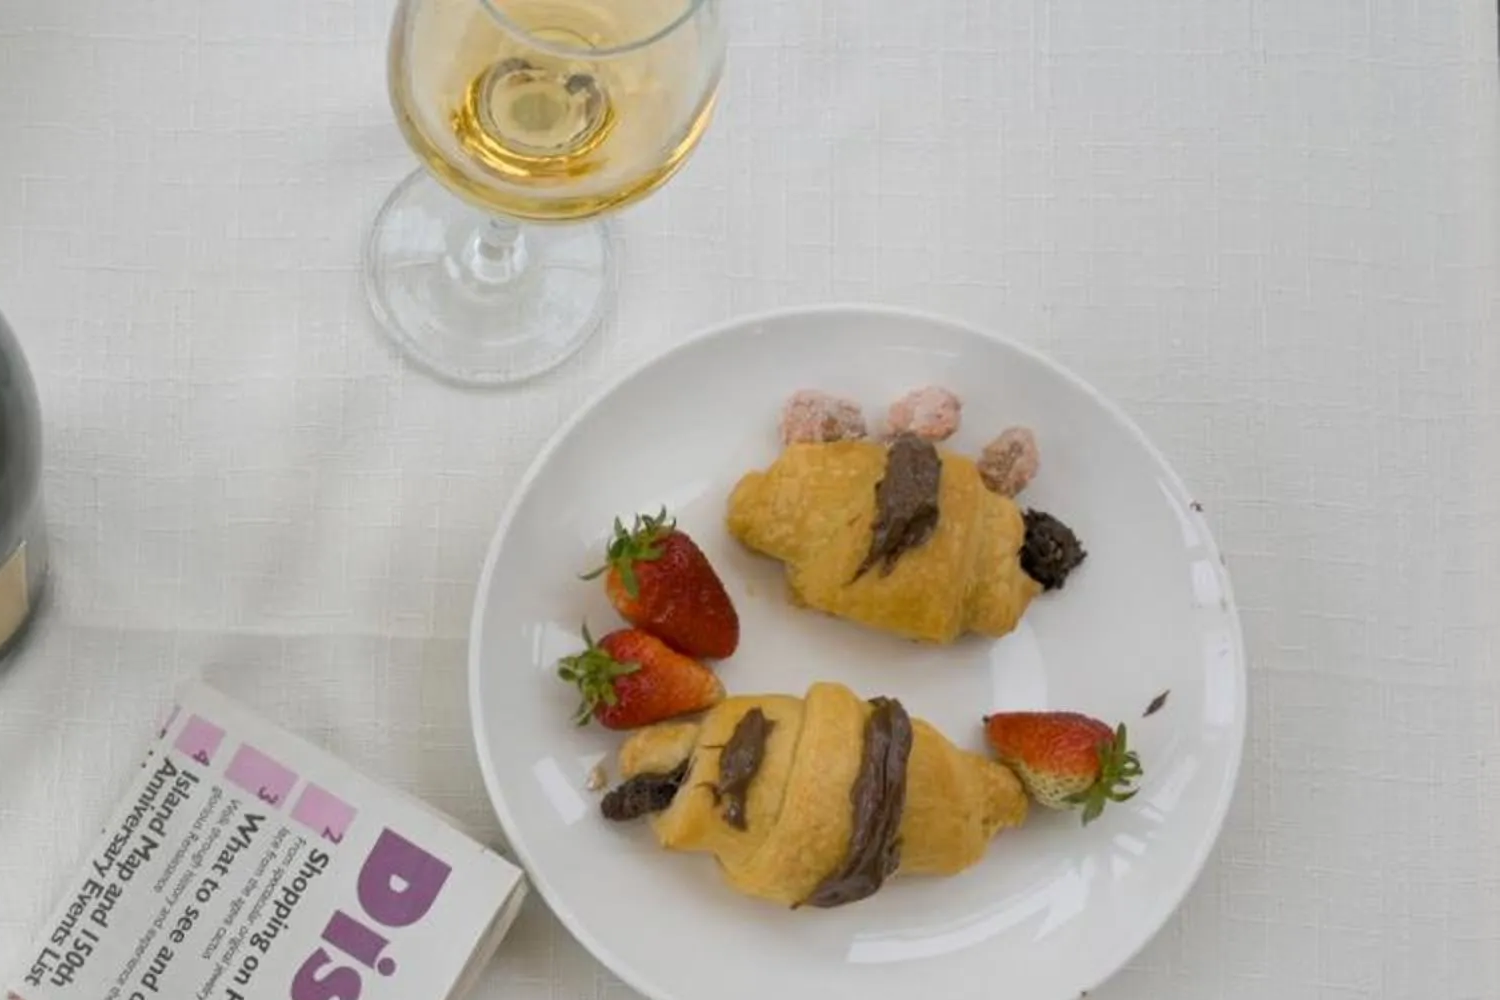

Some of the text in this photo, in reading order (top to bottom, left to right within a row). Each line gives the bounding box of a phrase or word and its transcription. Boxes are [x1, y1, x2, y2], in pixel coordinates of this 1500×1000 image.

[190, 748, 211, 767] 4
[92, 756, 178, 879] Anniversary
[147, 769, 200, 838] Island
[256, 785, 280, 806] 3
[116, 834, 160, 882] Map
[211, 813, 267, 877] What
[320, 825, 344, 845] 2
[50, 878, 105, 947] Events
[89, 882, 123, 928] and
[195, 877, 220, 904] to
[249, 848, 330, 954] Shopping
[169, 905, 200, 944] see
[24, 946, 61, 987] List
[49, 928, 100, 987] 150th
[140, 945, 174, 993] and
[233, 955, 259, 986] on
